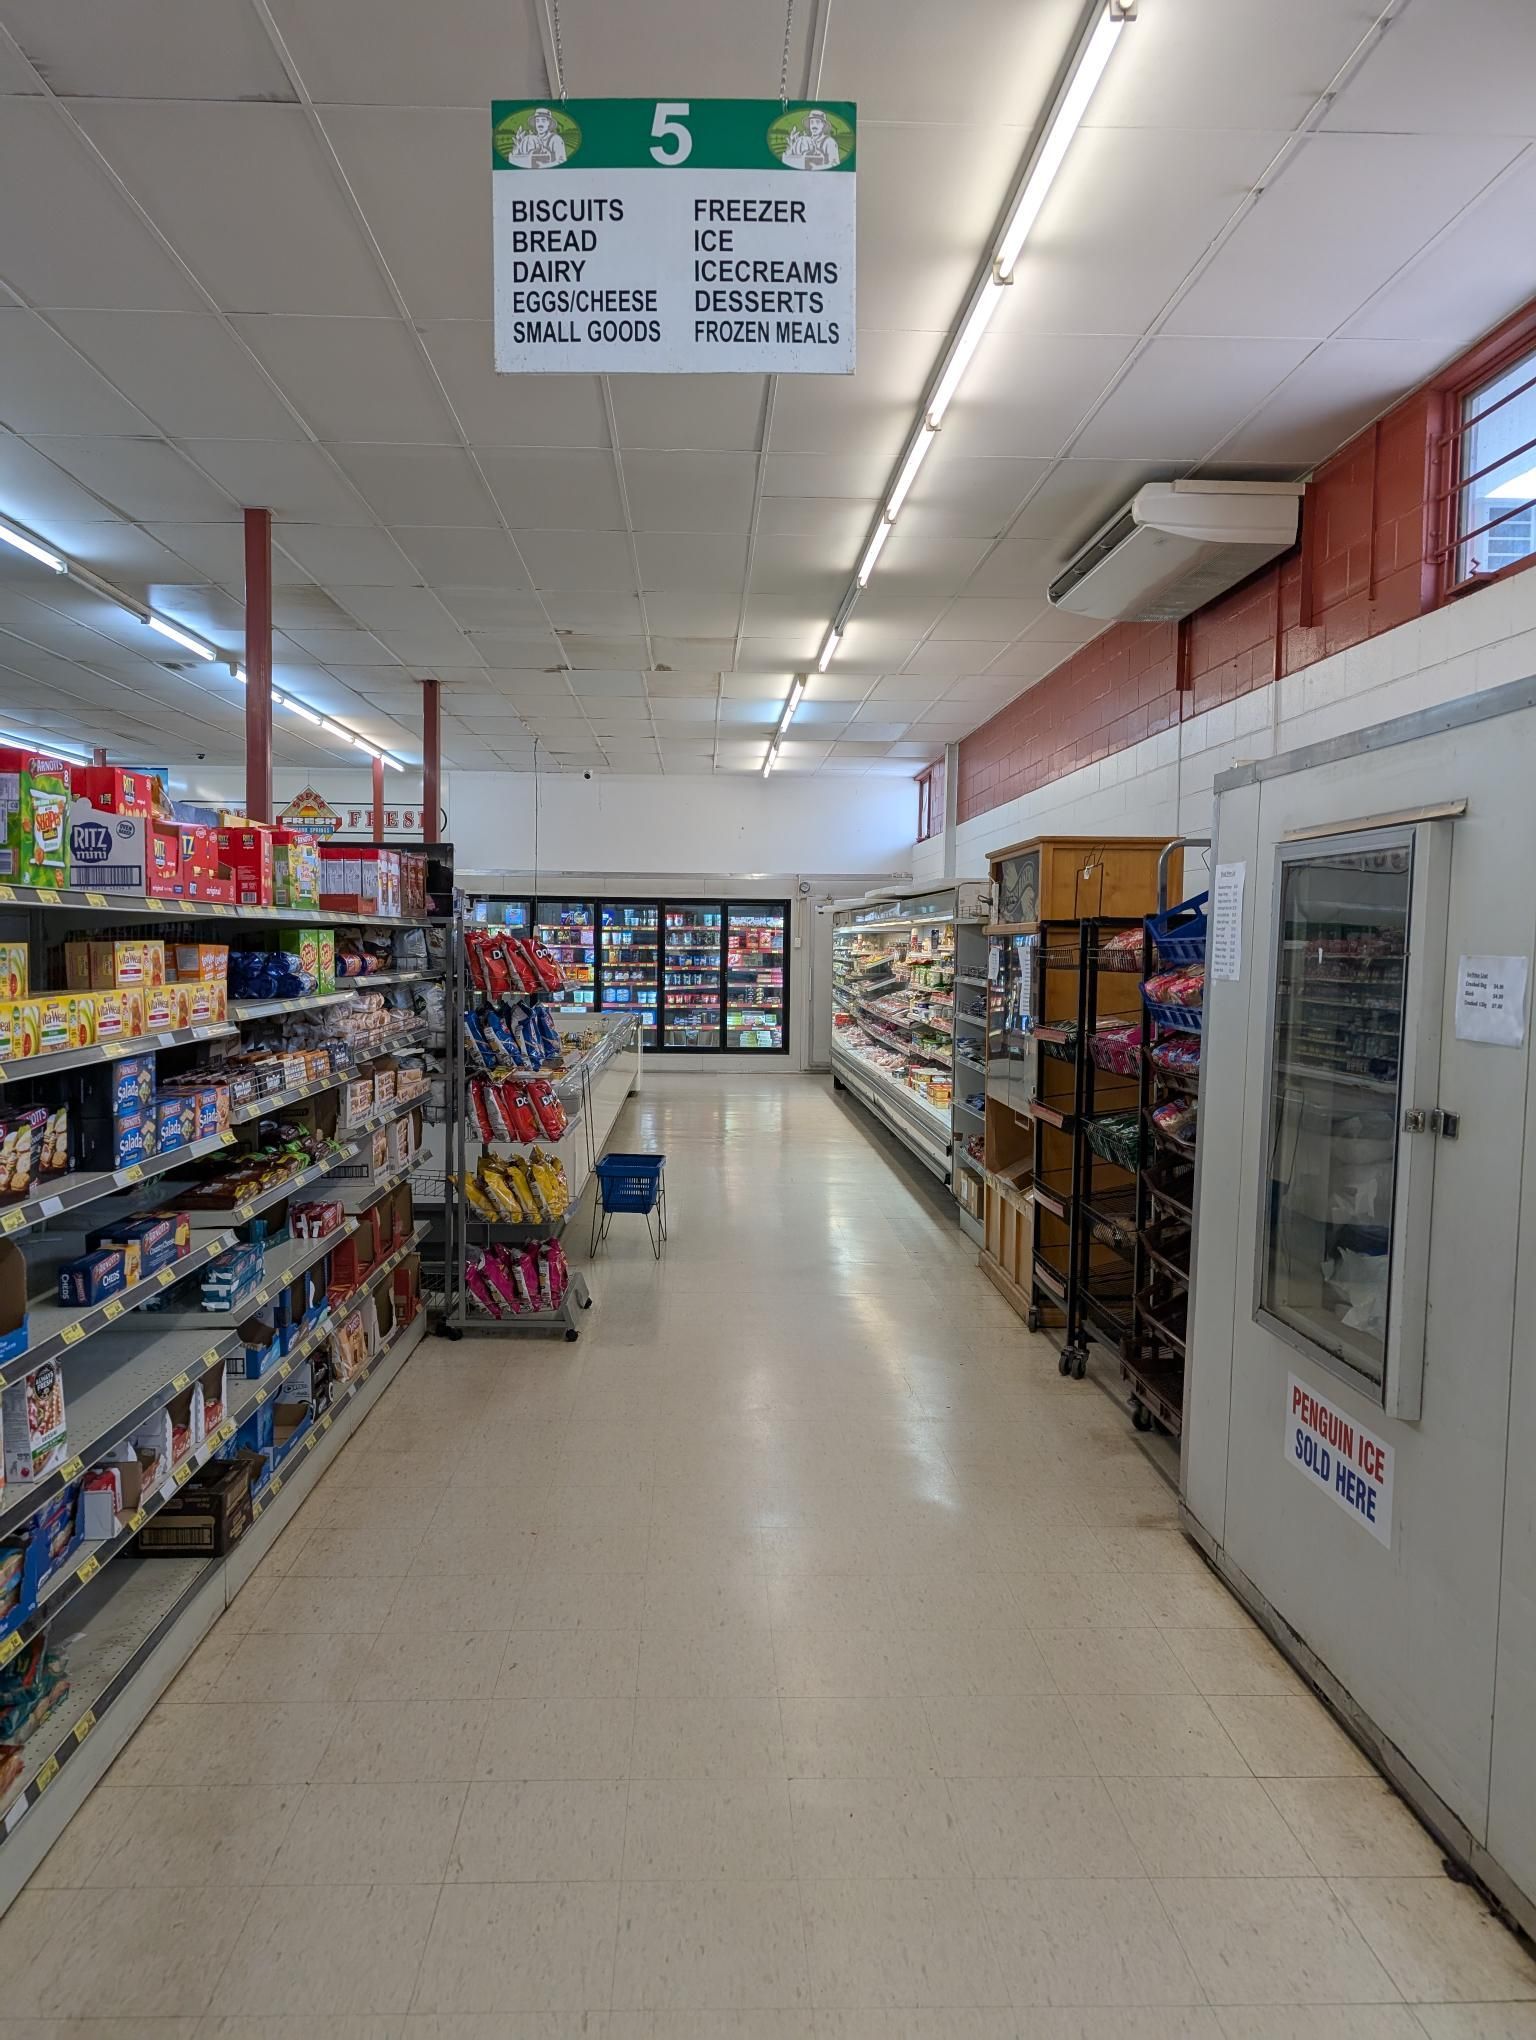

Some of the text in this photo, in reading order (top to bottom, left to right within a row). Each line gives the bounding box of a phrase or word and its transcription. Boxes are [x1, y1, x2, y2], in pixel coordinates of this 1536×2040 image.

[649, 102, 693, 165] 5
[512, 198, 625, 223] BISCUITS
[693, 199, 807, 223] FREEZER
[512, 229, 598, 253] BREAD
[693, 229, 734, 252] ICE
[512, 259, 587, 283] DAIRY
[693, 259, 839, 284] ICECREAMS
[512, 289, 658, 313] EGGS/CHEESE
[694, 290, 824, 314] DESSERTS
[512, 320, 662, 343] SMALL GOODS
[694, 320, 840, 344] FROZEN MEALS
[282, 817, 337, 825] FRESH
[347, 809, 425, 829] FES
[73, 827, 107, 849] RITZ
[76, 848, 107, 860] mini
[117, 1081, 139, 1104] Salada
[160, 1120, 181, 1141] Salada
[119, 1132, 142, 1157] Salada
[61, 1273, 70, 1300] CHEDS
[102, 1270, 121, 1286] CHEDS
[1292, 1384, 1385, 1485] PENGUIN ICE
[1295, 1428, 1377, 1524] SOLD HERE
